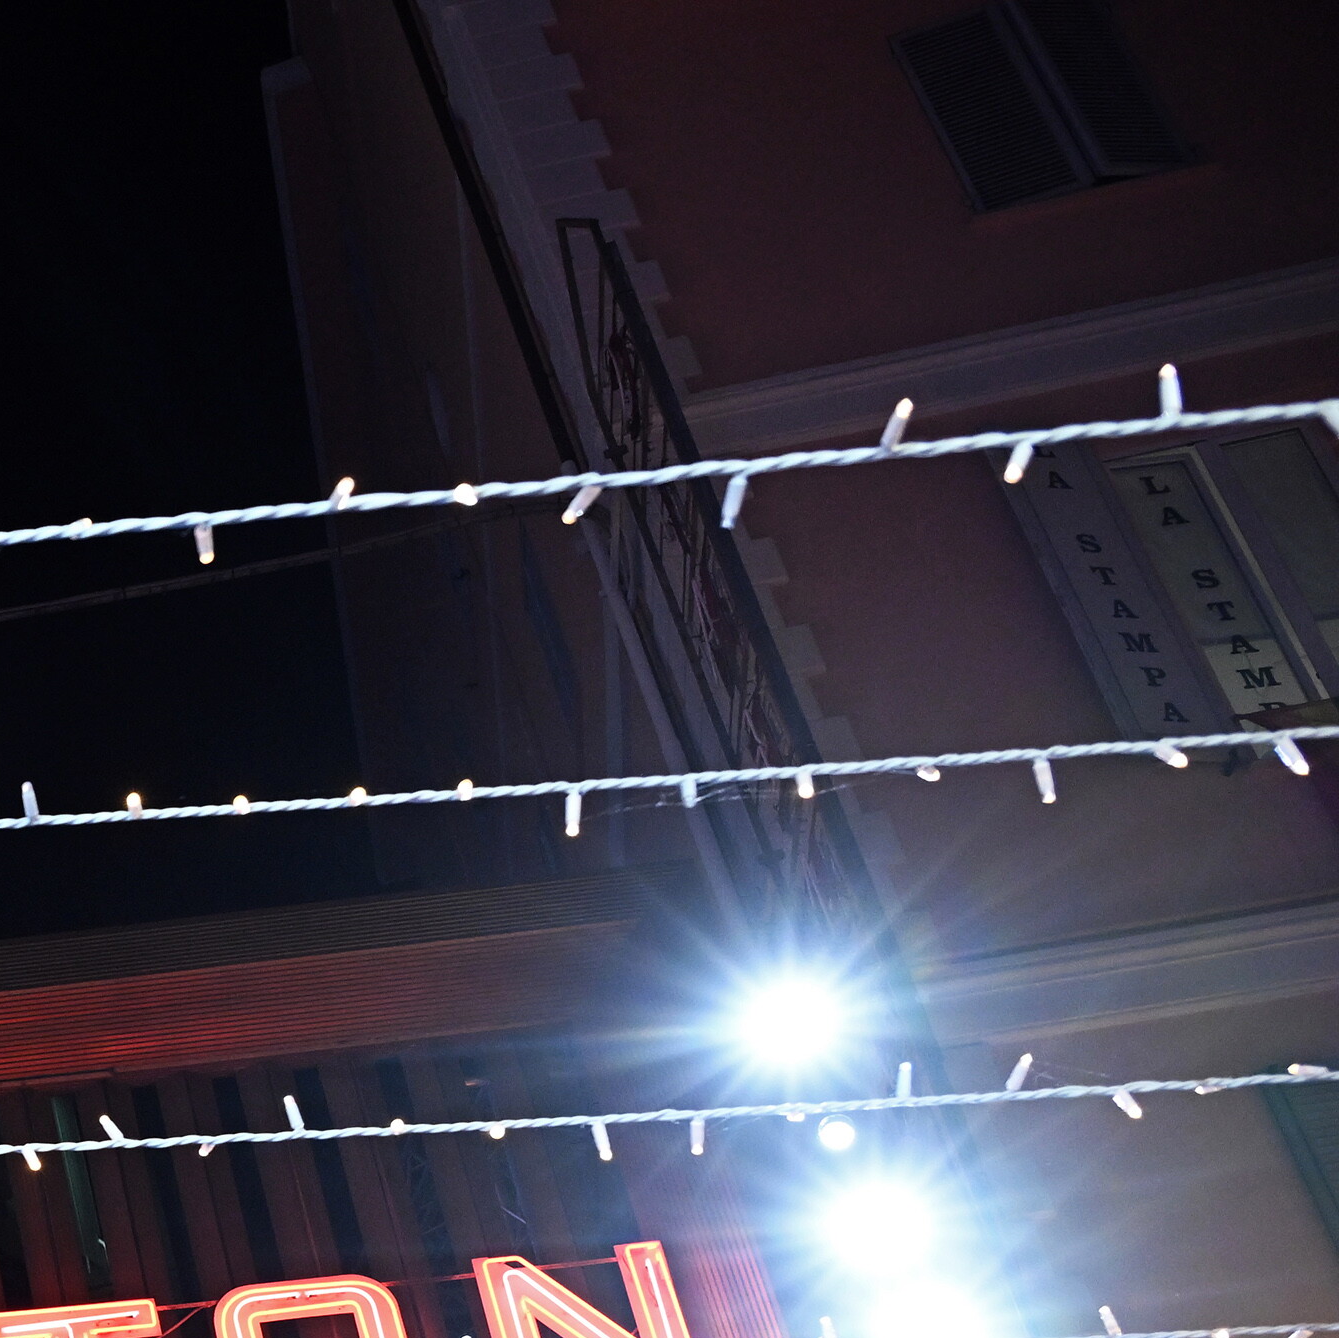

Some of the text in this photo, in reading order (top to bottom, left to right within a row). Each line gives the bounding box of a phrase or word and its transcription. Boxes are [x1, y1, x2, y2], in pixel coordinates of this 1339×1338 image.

[1076, 534, 1190, 723] STAMPA
[1139, 475, 1289, 713] LA STAM
